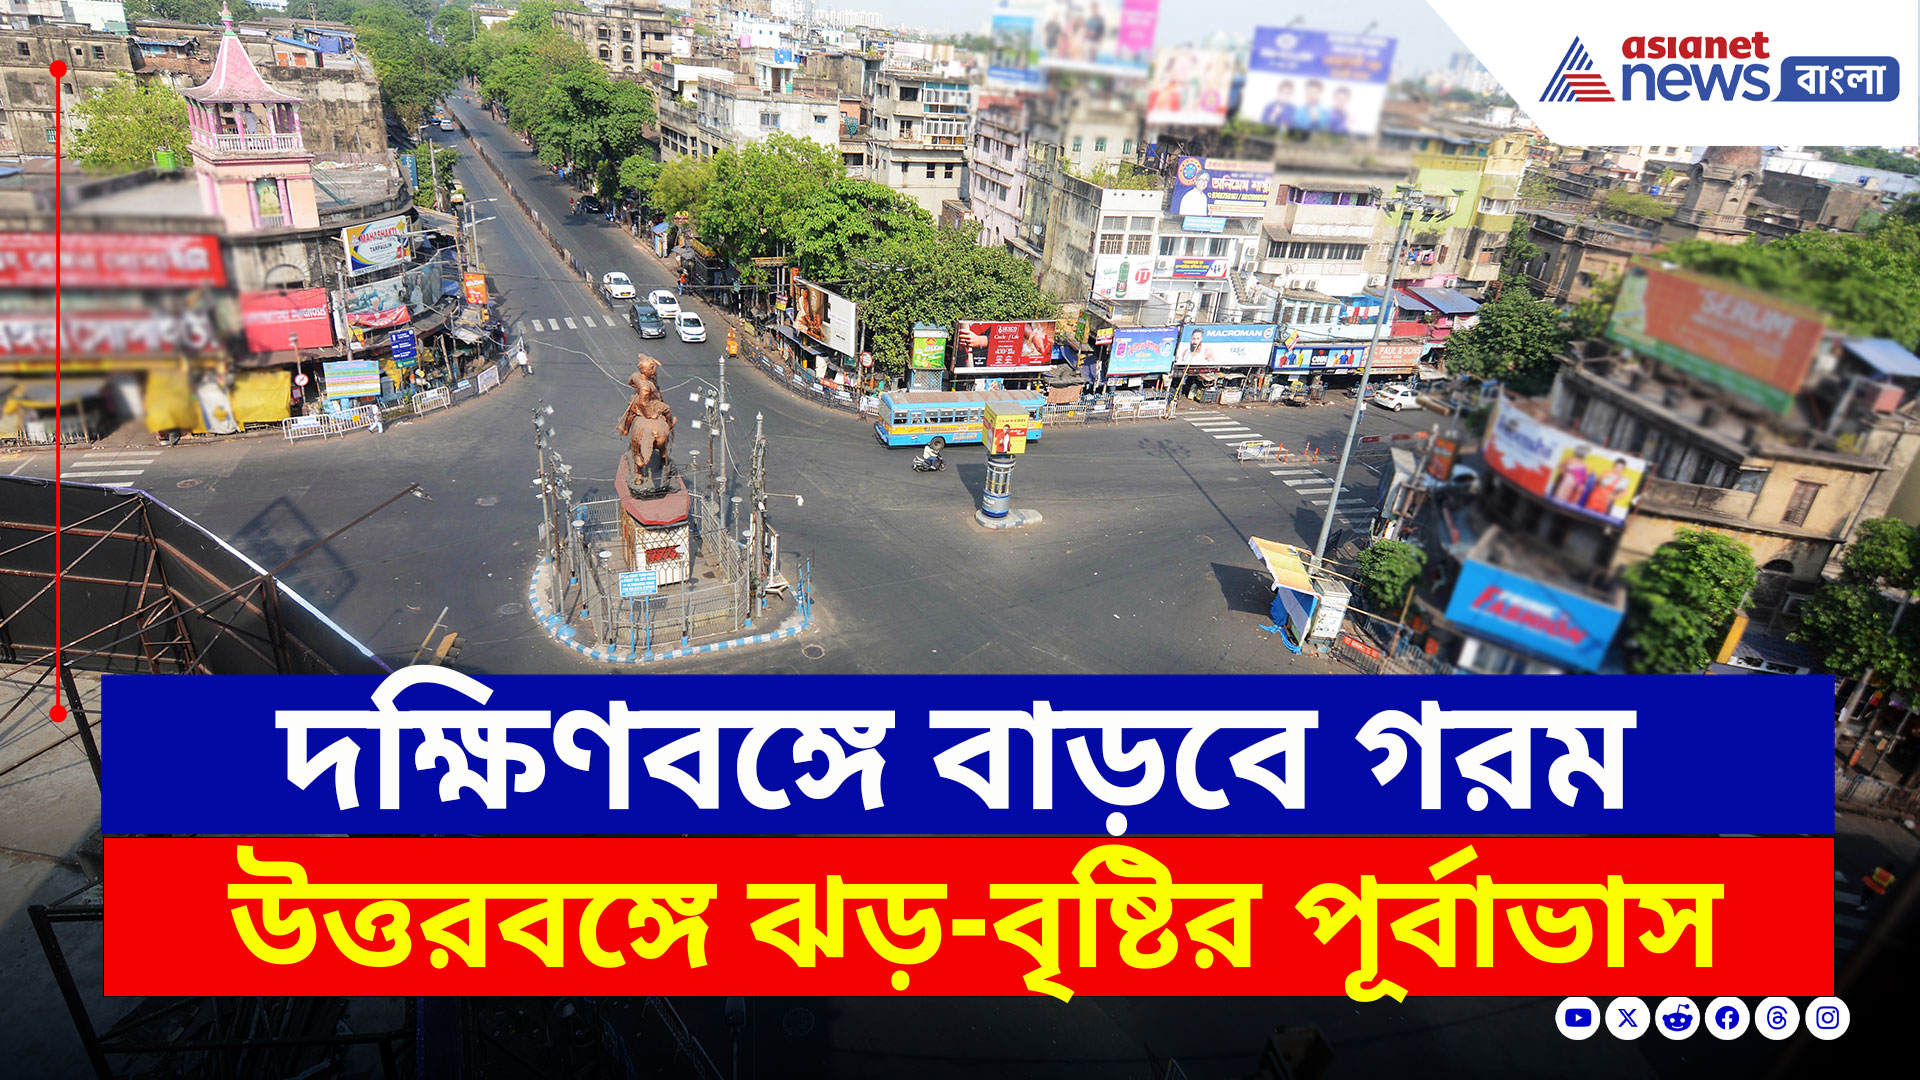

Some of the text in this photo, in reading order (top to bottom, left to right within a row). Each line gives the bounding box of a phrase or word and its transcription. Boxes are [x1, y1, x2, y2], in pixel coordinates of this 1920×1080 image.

[1206, 329, 1263, 338] MACROMAN
[1379, 346, 1398, 355] PAUL
[1404, 346, 1423, 355] SONS
[1471, 585, 1588, 646] FASHION
